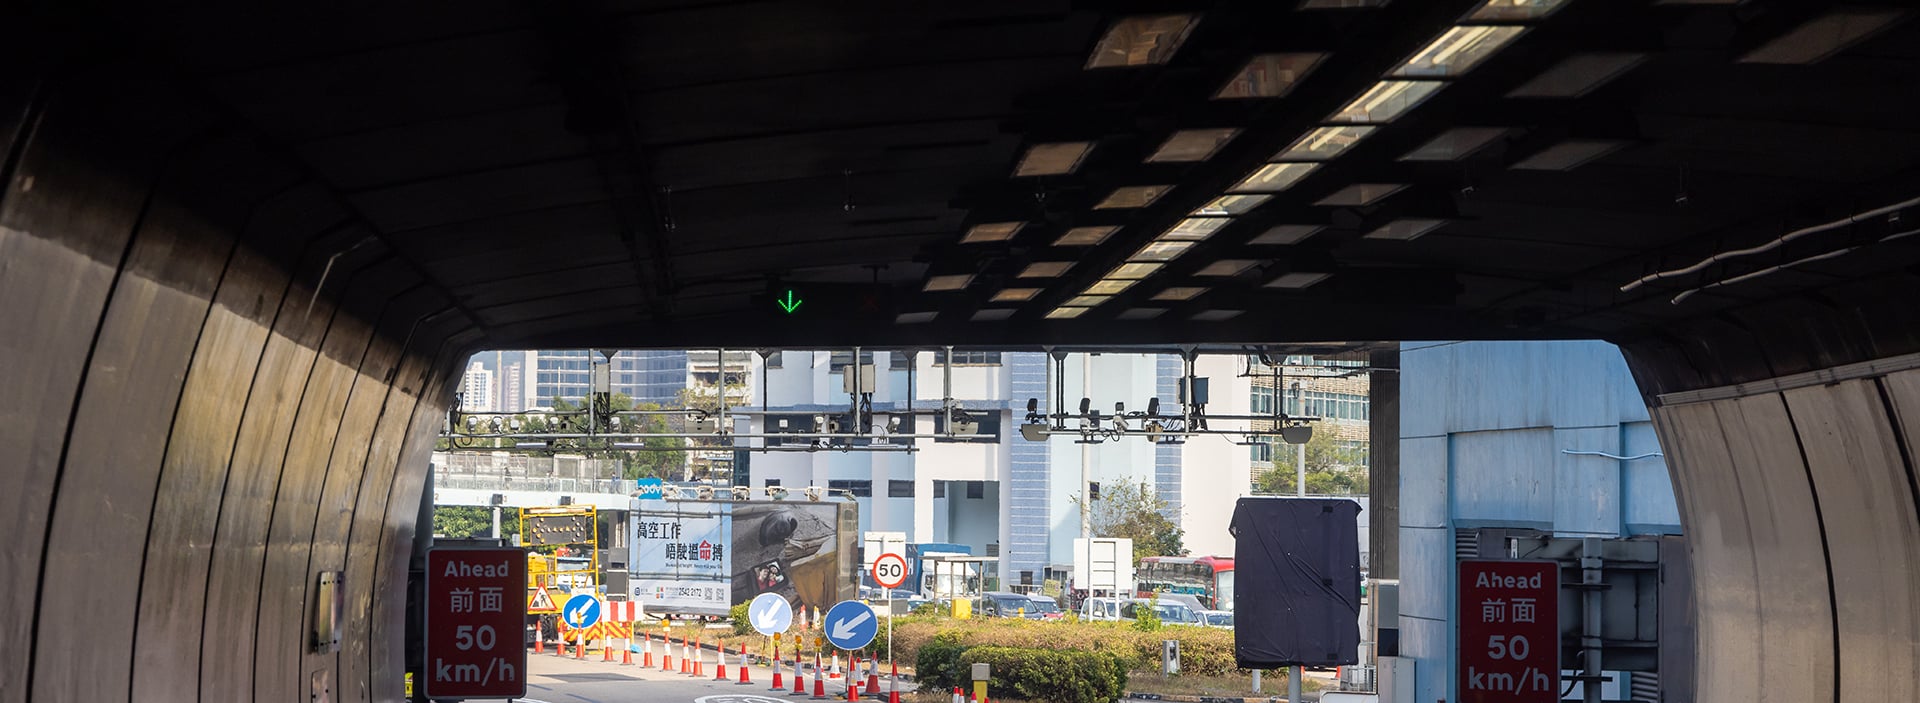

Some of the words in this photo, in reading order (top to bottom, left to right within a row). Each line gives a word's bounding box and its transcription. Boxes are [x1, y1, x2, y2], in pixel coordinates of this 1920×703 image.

[637, 521, 682, 539] 高空工作
[444, 560, 509, 577] Ahead
[879, 563, 901, 577] 50
[1475, 571, 1542, 589] Ahead
[449, 587, 503, 613] 前面
[1481, 598, 1537, 623] 前面
[456, 624, 496, 650] 50
[1487, 634, 1530, 661] 50
[435, 657, 515, 687] km/h
[1468, 665, 1550, 696] km/h
